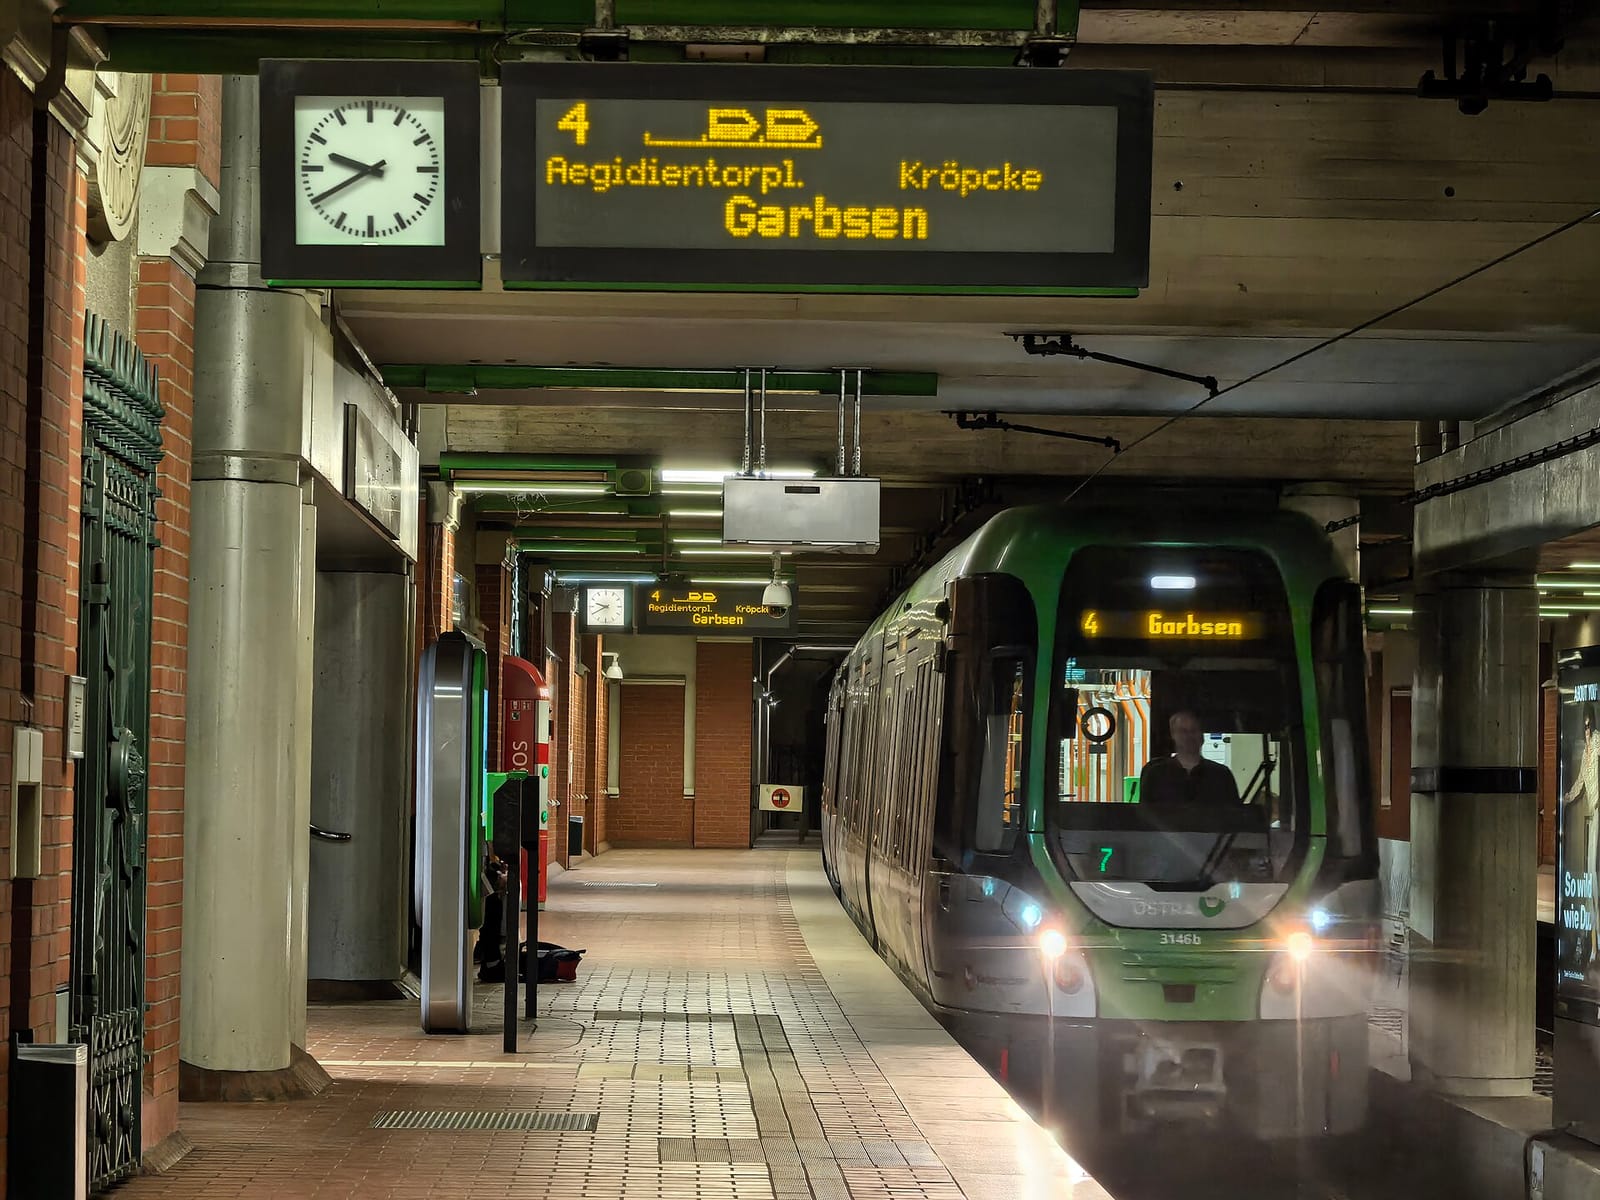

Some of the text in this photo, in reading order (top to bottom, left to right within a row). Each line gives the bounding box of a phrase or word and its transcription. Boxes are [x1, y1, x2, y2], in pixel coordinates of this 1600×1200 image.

[557, 103, 589, 145] 4
[546, 156, 804, 195] Aegidientorpl.
[899, 160, 1042, 198] Kröpcke
[725, 195, 928, 240] Garbsen
[648, 604, 713, 613] Aegidientorpl.
[651, 591, 660, 602] 4
[692, 614, 744, 625] Garbsen
[735, 605, 769, 614] Kröpck
[1084, 612, 1098, 634] 4
[1148, 613, 1243, 635] Garbsen
[512, 741, 529, 771] OS
[1100, 848, 1113, 872] 7
[1564, 871, 1593, 899] So wild
[1563, 903, 1579, 929] wie
[1159, 933, 1202, 946] 3146b
